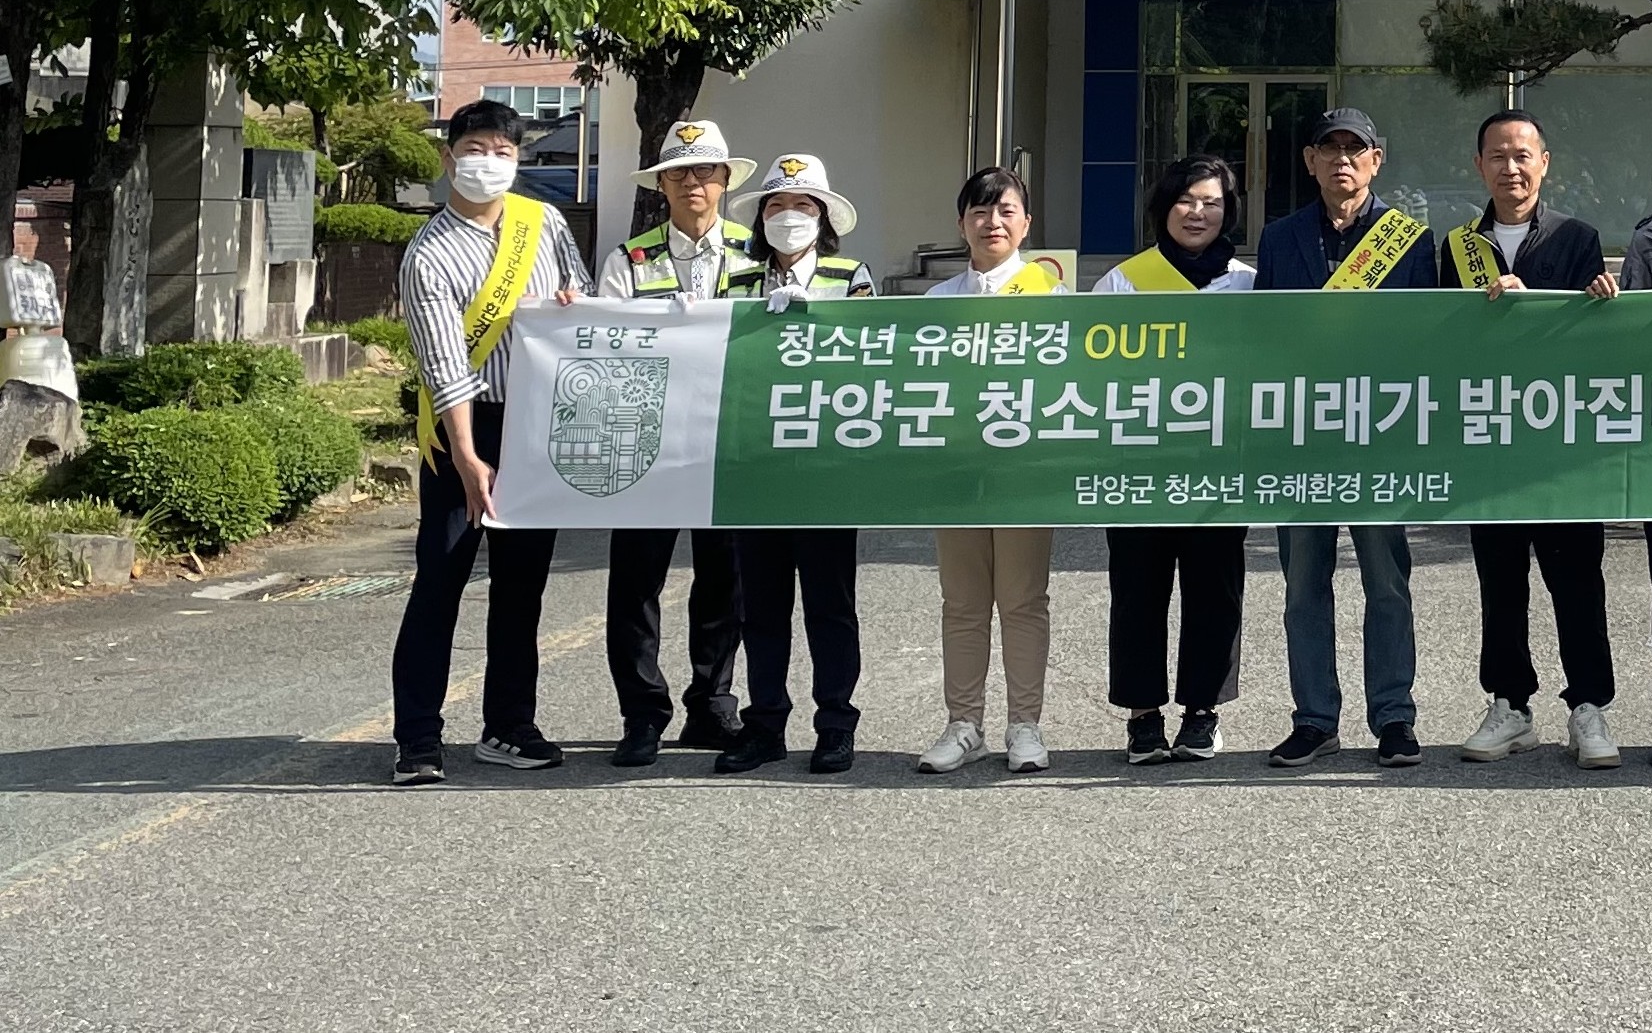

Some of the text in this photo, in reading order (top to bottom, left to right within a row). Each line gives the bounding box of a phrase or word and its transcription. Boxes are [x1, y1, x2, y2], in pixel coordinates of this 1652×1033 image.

[575, 326, 659, 350] 담양군
[776, 320, 1188, 368] 청소년 유해환경 OUT!
[768, 378, 955, 449] 담양군
[975, 376, 1226, 449] 청소년의
[1250, 375, 1439, 447] 미래가
[1075, 471, 1453, 506] 담양군 청소년 유해환경 감시단
